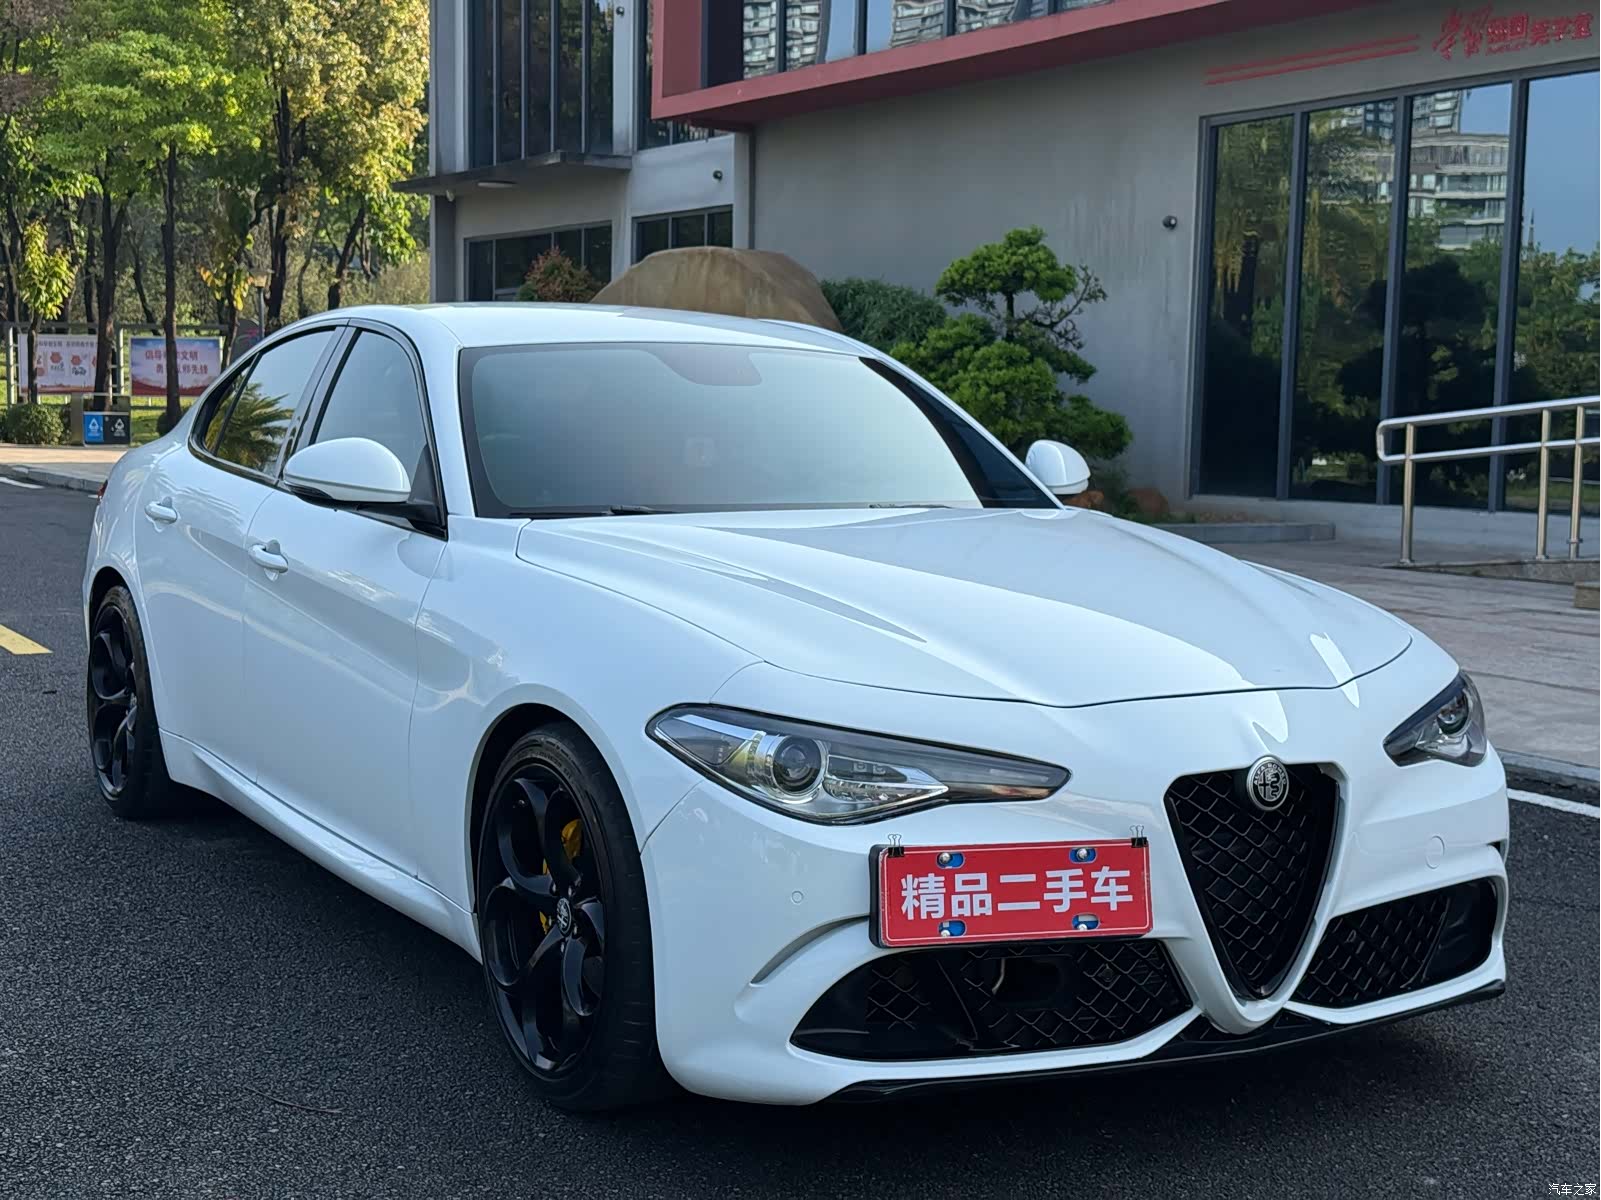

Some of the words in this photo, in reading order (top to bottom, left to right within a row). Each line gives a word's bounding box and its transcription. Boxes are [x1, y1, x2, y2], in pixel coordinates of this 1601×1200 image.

[1254, 766, 1265, 785] ALFA
[1268, 763, 1287, 785] ROMEO
[901, 866, 1133, 920] 精品二手车
